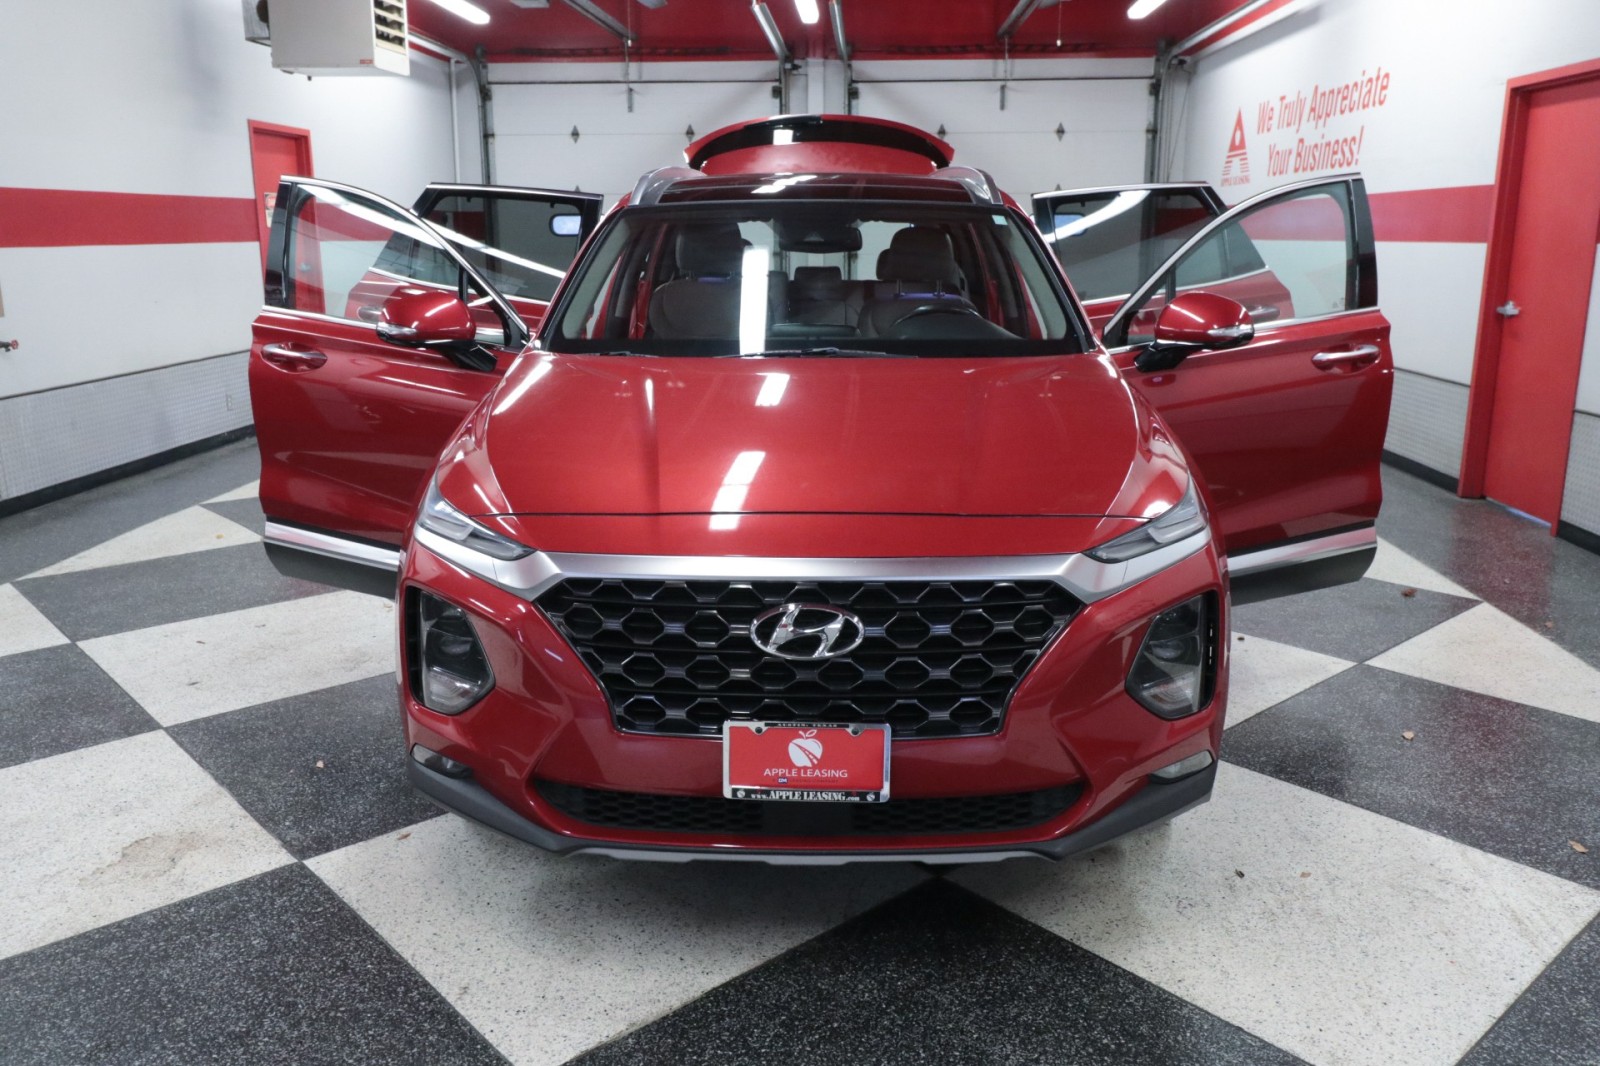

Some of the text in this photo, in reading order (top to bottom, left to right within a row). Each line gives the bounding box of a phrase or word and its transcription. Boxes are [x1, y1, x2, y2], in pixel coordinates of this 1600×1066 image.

[1257, 66, 1390, 135] We Truly Appreciate
[1267, 125, 1364, 177] Your Business!
[763, 768, 848, 778] APPLE LEASING
